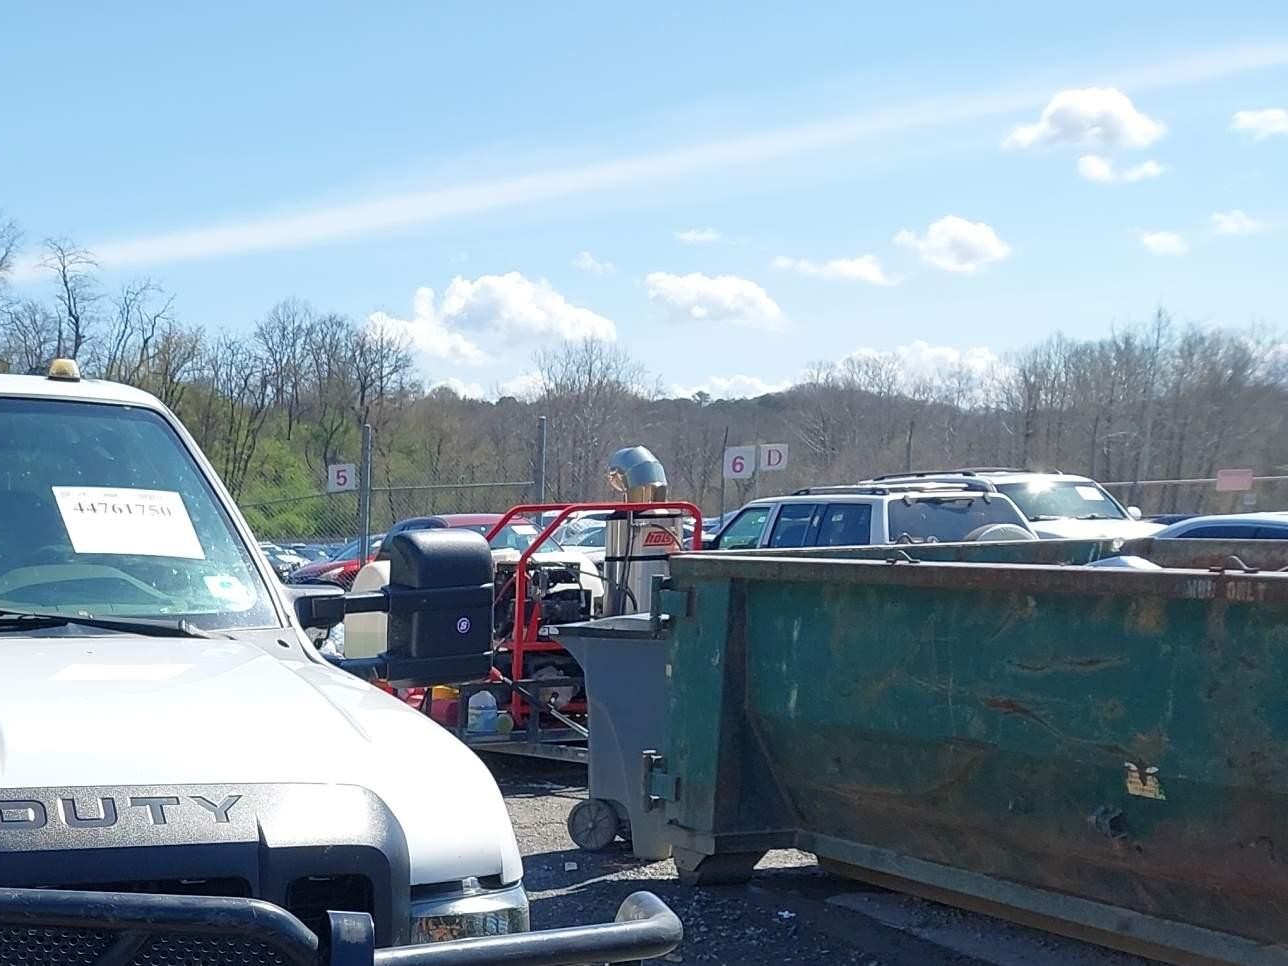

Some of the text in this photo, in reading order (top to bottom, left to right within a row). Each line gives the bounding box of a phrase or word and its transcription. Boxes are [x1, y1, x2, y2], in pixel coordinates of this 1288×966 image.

[732, 455, 745, 473] 6
[767, 448, 783, 467] D
[336, 469, 348, 486] 5
[72, 501, 173, 518] 44761750
